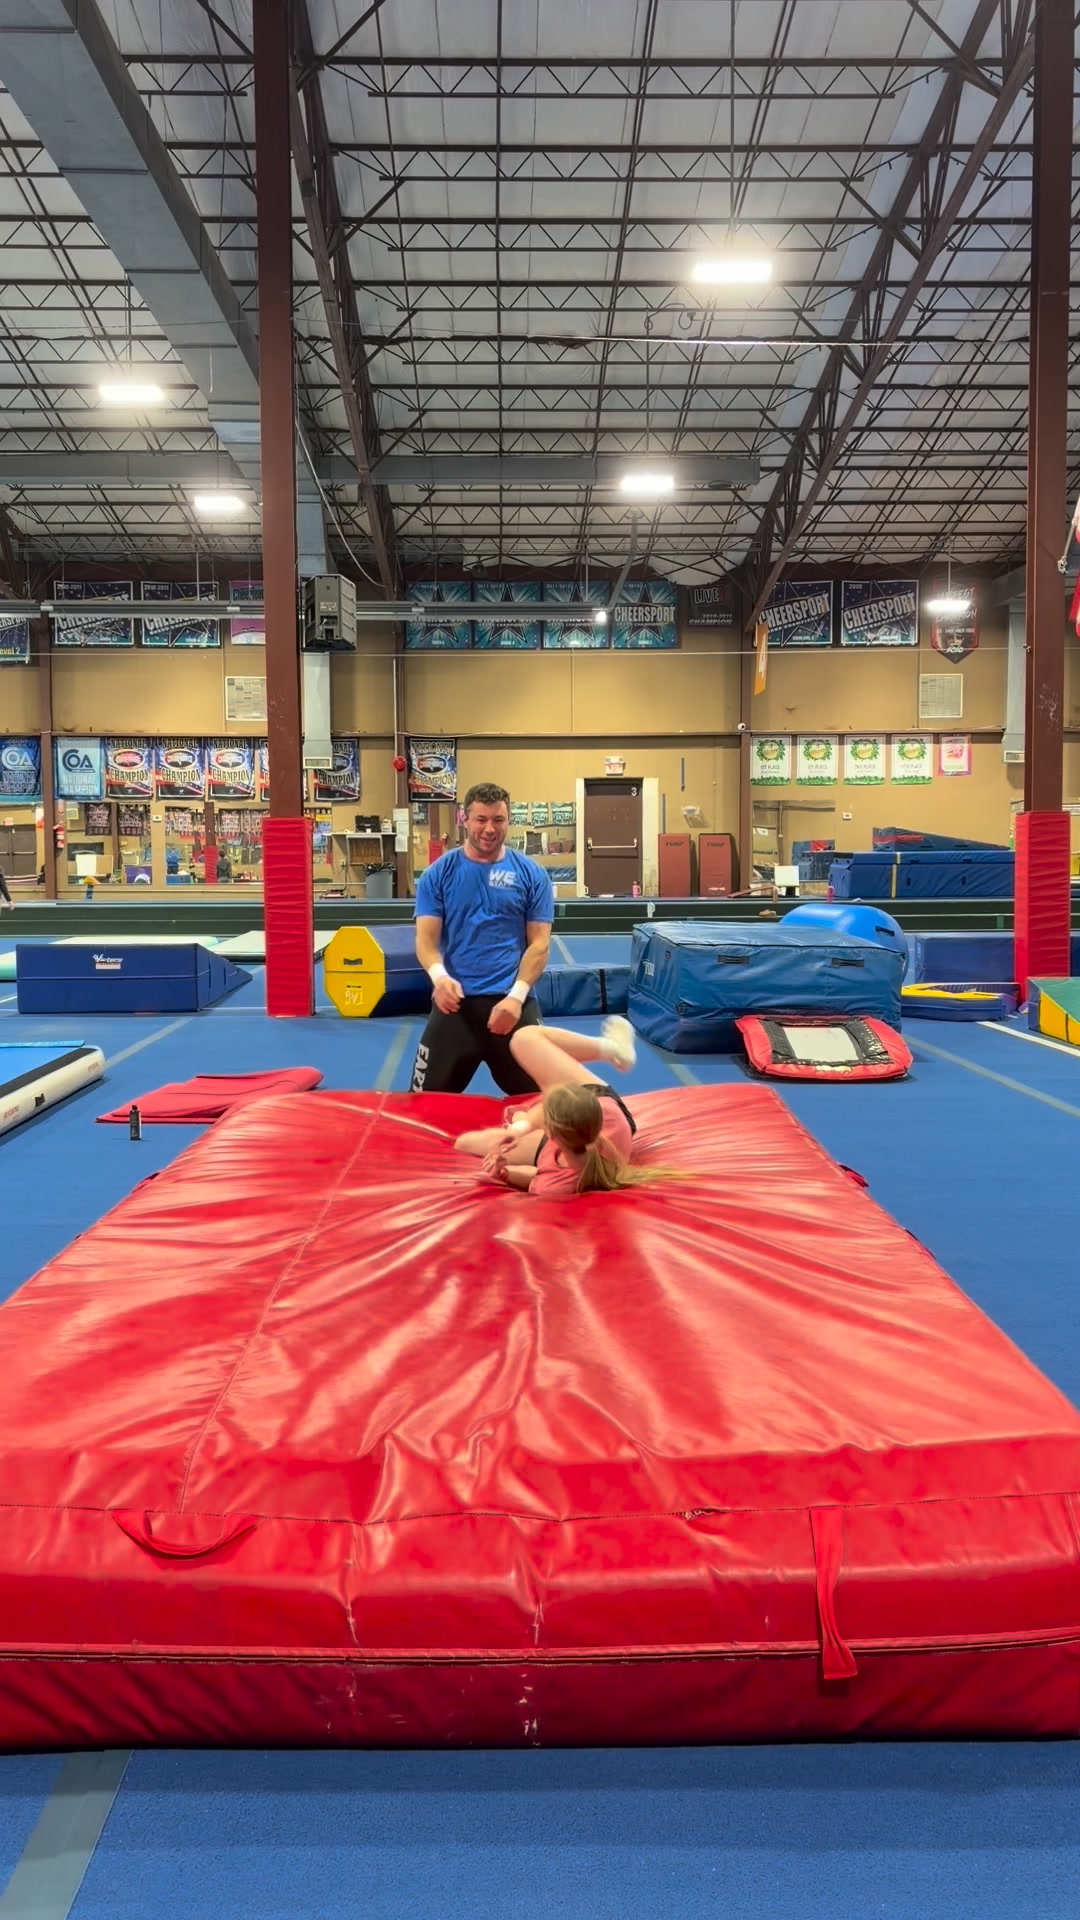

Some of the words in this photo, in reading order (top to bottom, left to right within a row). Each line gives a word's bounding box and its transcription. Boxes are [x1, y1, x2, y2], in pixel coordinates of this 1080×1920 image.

[694, 588, 720, 604] LIVE
[614, 606, 676, 622] CHEERSPORT
[843, 592, 916, 630] CHEERSPORT
[16, 647, 21, 655] 2
[109, 739, 146, 749] NATIONAL
[162, 739, 199, 749] NATIONAL
[213, 739, 248, 749] NATIONAL
[62, 748, 96, 773] COA
[109, 769, 149, 783] CHAMPION
[161, 769, 201, 783] CHAMPION
[212, 768, 251, 783] CHAMPION
[318, 772, 356, 785] CHAMPION
[631, 786, 637, 797] 3
[489, 869, 517, 884] WE
